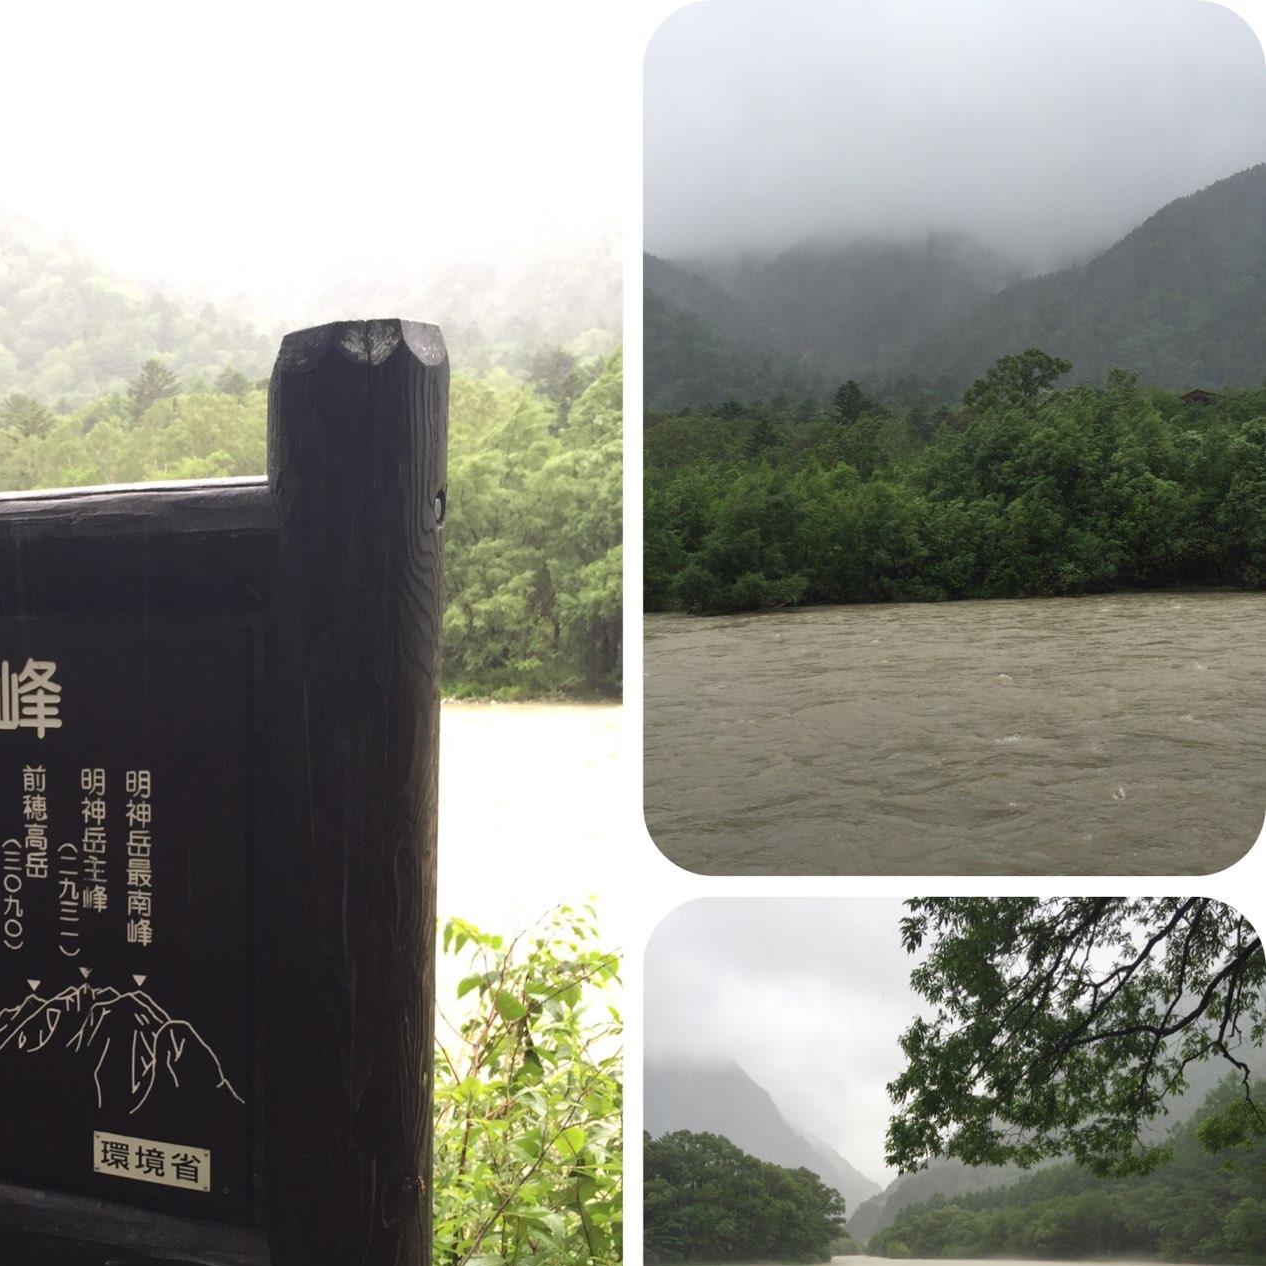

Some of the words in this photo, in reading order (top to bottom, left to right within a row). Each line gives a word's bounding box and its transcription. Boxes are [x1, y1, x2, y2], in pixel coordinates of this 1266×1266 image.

[23, 765, 48, 878] 前穂高岳
[81, 768, 107, 912] 明神岳主峰
[126, 770, 152, 946] 明神岳最南峰
[100, 1141, 202, 1184] 環境省
